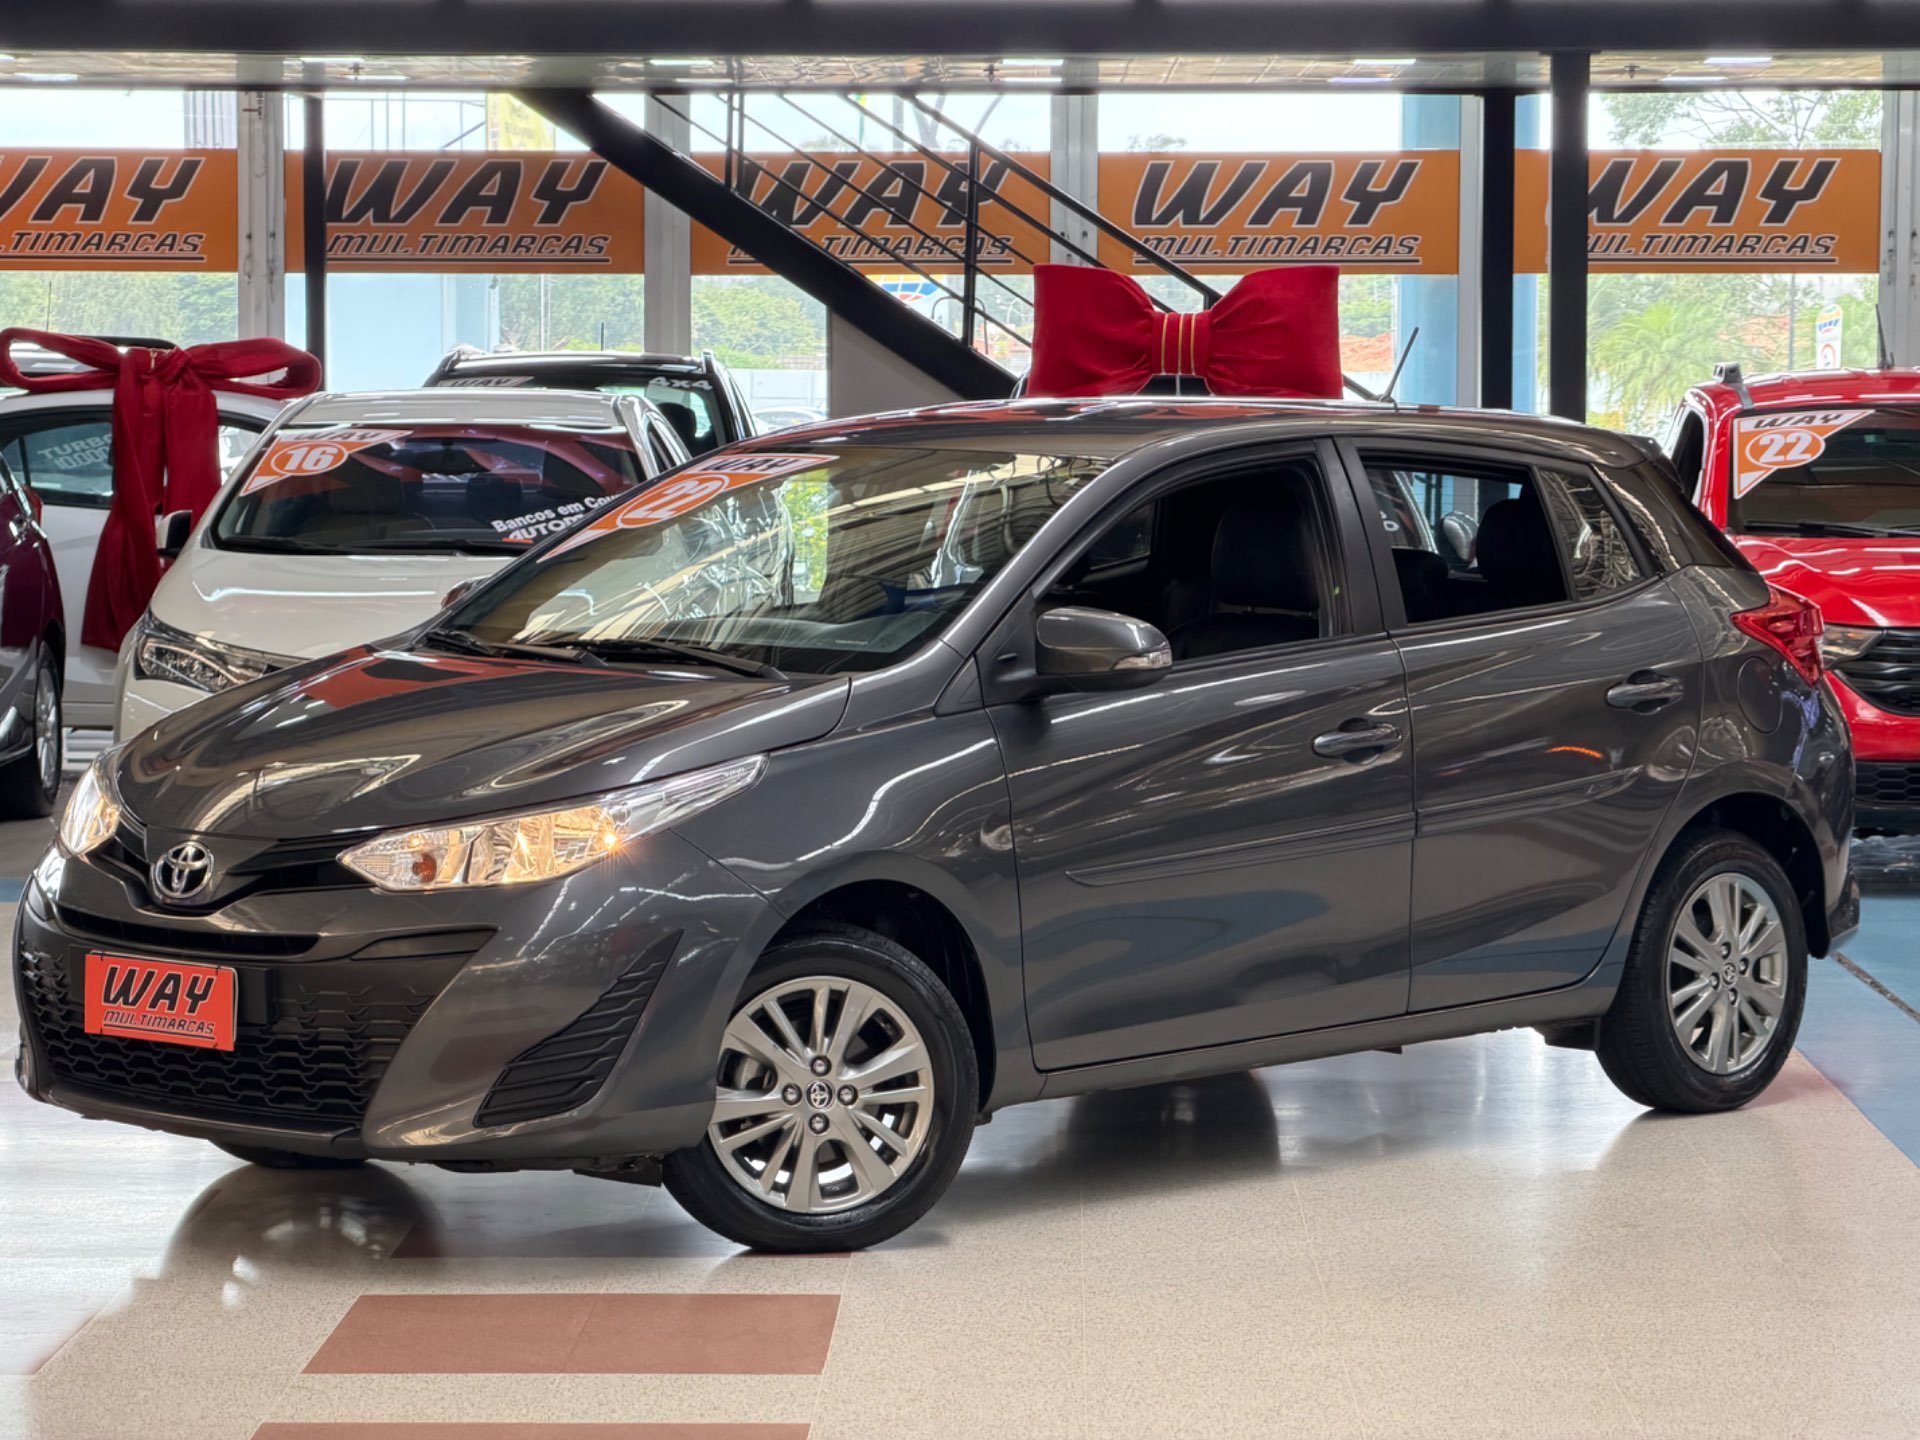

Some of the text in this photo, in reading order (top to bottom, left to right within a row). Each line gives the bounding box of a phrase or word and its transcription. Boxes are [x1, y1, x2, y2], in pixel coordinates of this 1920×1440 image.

[325, 158, 610, 227] WAY
[1132, 159, 1424, 229] WAY
[0, 230, 206, 254] TIMARCAS
[326, 231, 611, 256] MULTIMARCAS
[1134, 234, 1423, 257] MULTIMARCAS
[1586, 232, 1839, 256] ULTIMARCAS
[1754, 413, 1843, 429] WAY
[283, 446, 339, 471] 16
[1758, 431, 1812, 463] 22
[491, 509, 556, 533] Bancos
[557, 502, 585, 516] em
[102, 964, 217, 1016] WAY
[103, 1010, 216, 1035] MULTIMARCAS
